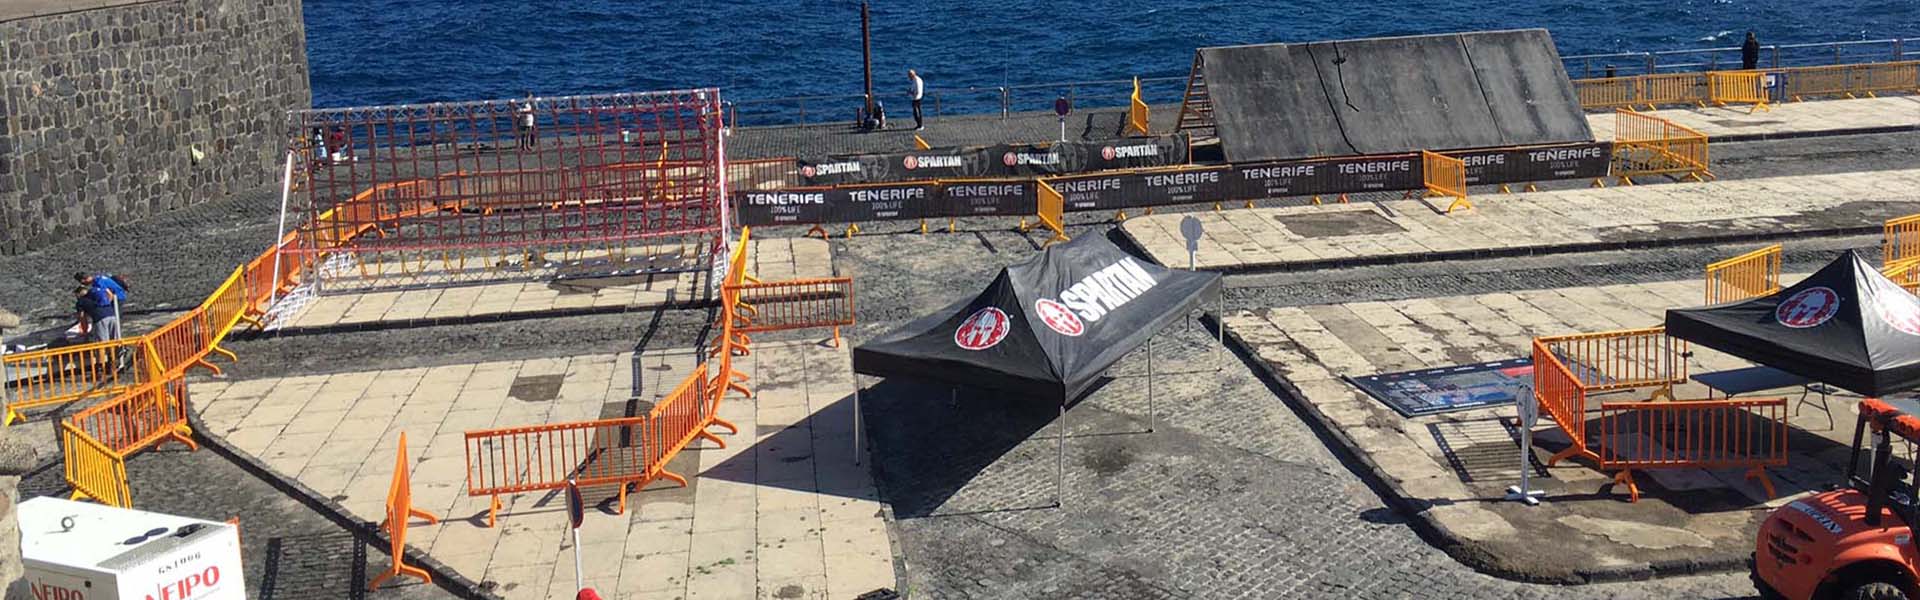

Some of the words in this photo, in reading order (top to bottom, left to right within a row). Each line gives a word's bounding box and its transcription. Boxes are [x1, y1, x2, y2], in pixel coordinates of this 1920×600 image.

[1115, 145, 1158, 158] SPARTAN
[1529, 147, 1601, 162] TENERIFE
[917, 155, 962, 168] SPARTAN
[1017, 152, 1060, 165] SPARTAN
[815, 161, 861, 175] SPARTAN
[1242, 165, 1315, 180] TENERIFE
[1338, 161, 1410, 174] TENERIFE
[1144, 171, 1220, 186] TENERIFE
[849, 187, 925, 202] TENERIFE
[948, 184, 1024, 197] TENERIFE
[746, 192, 825, 205] TENERIFE
[1059, 256, 1160, 322] SPARTAN
